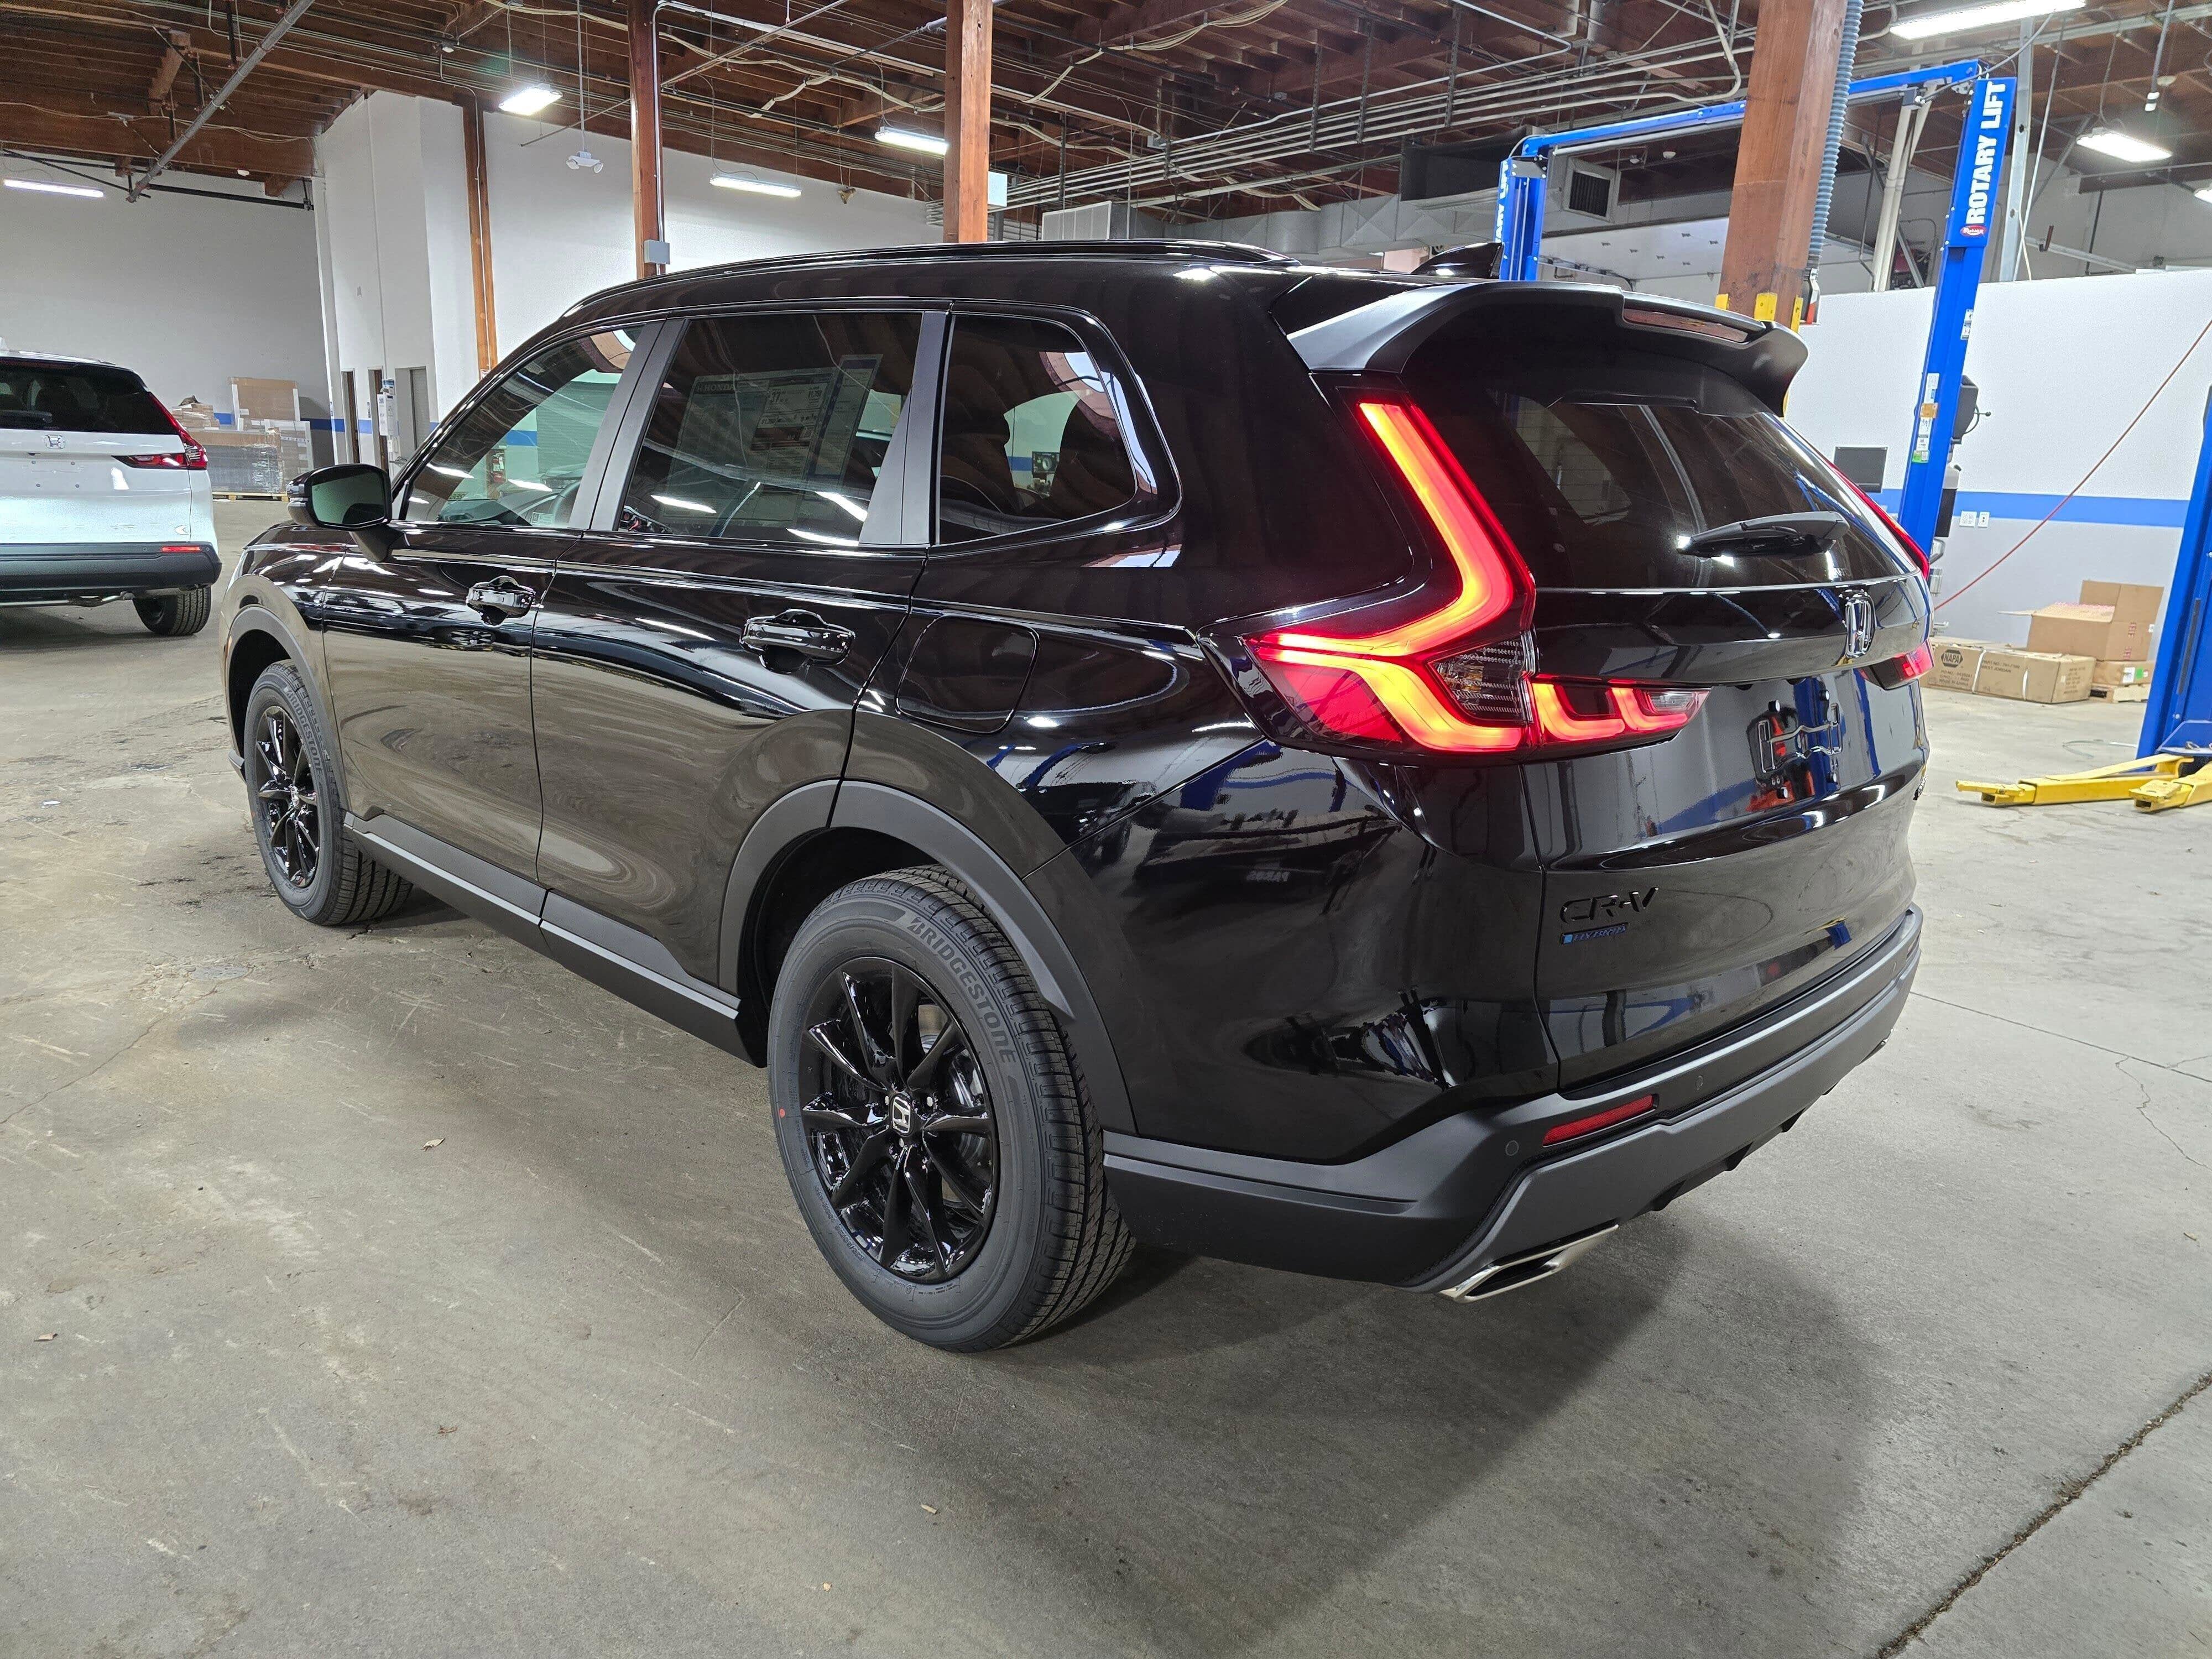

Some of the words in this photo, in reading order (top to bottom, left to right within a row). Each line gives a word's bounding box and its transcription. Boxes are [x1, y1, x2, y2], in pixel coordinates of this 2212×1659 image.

[1980, 81, 2006, 129] LIFT
[1966, 135, 1997, 224] ROTARY
[1944, 653, 1960, 664] NAPA
[285, 690, 324, 778] BRIDGESTONE
[1560, 886, 1659, 924] CR-V
[906, 916, 1017, 1063] BRIDGESTONE
